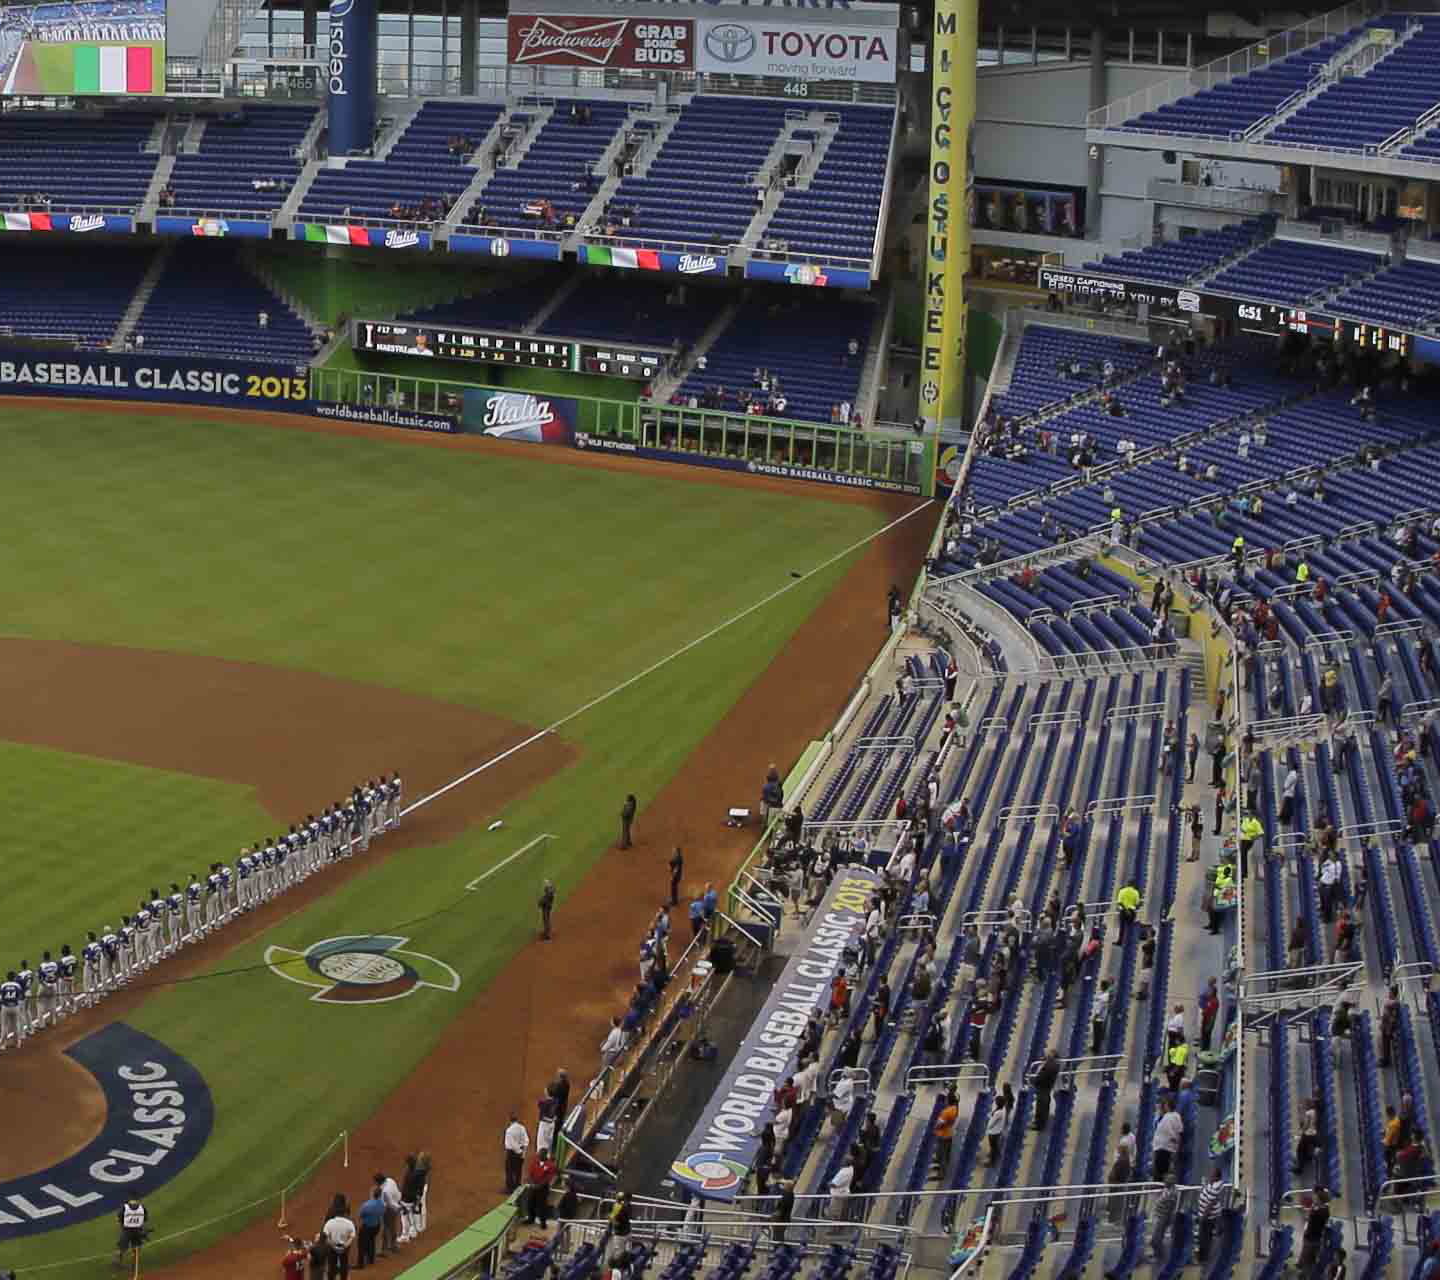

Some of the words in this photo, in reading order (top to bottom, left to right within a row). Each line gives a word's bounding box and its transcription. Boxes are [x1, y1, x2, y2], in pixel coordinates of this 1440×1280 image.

[519, 27, 624, 49] Budweiser
[634, 25, 687, 40] GRAB
[643, 39, 678, 49] SOME
[762, 31, 889, 62] TOYOTA
[329, 21, 348, 95] pepsi
[634, 48, 686, 64] BUDS
[767, 62, 809, 77] moving
[811, 62, 857, 76] forward
[784, 82, 808, 97] 448
[70, 214, 106, 232] Italia
[385, 230, 421, 249] Italia
[677, 254, 717, 273] Italia
[1109, 289, 1126, 300] TO
[1129, 293, 1156, 305] YOU
[1237, 303, 1263, 322] 6:51
[600, 362, 607, 372] 0
[622, 365, 629, 374] 0
[643, 367, 651, 376] 0
[0, 360, 129, 388] BASEBALL
[135, 367, 240, 395] CLASSIC
[246, 375, 308, 401] 2013
[316, 405, 451, 431] worldbaseballclassic.com
[482, 395, 554, 438] Italia
[758, 465, 787, 475] WORLD
[790, 468, 833, 481] BASEBALL
[835, 474, 873, 487] CLASSIC
[700, 1073, 776, 1152] WORLD
[744, 982, 824, 1073] BASEBALL
[797, 912, 857, 978] CLASSIC
[831, 878, 872, 913] 2013
[89, 1061, 186, 1185] CLASSIC
